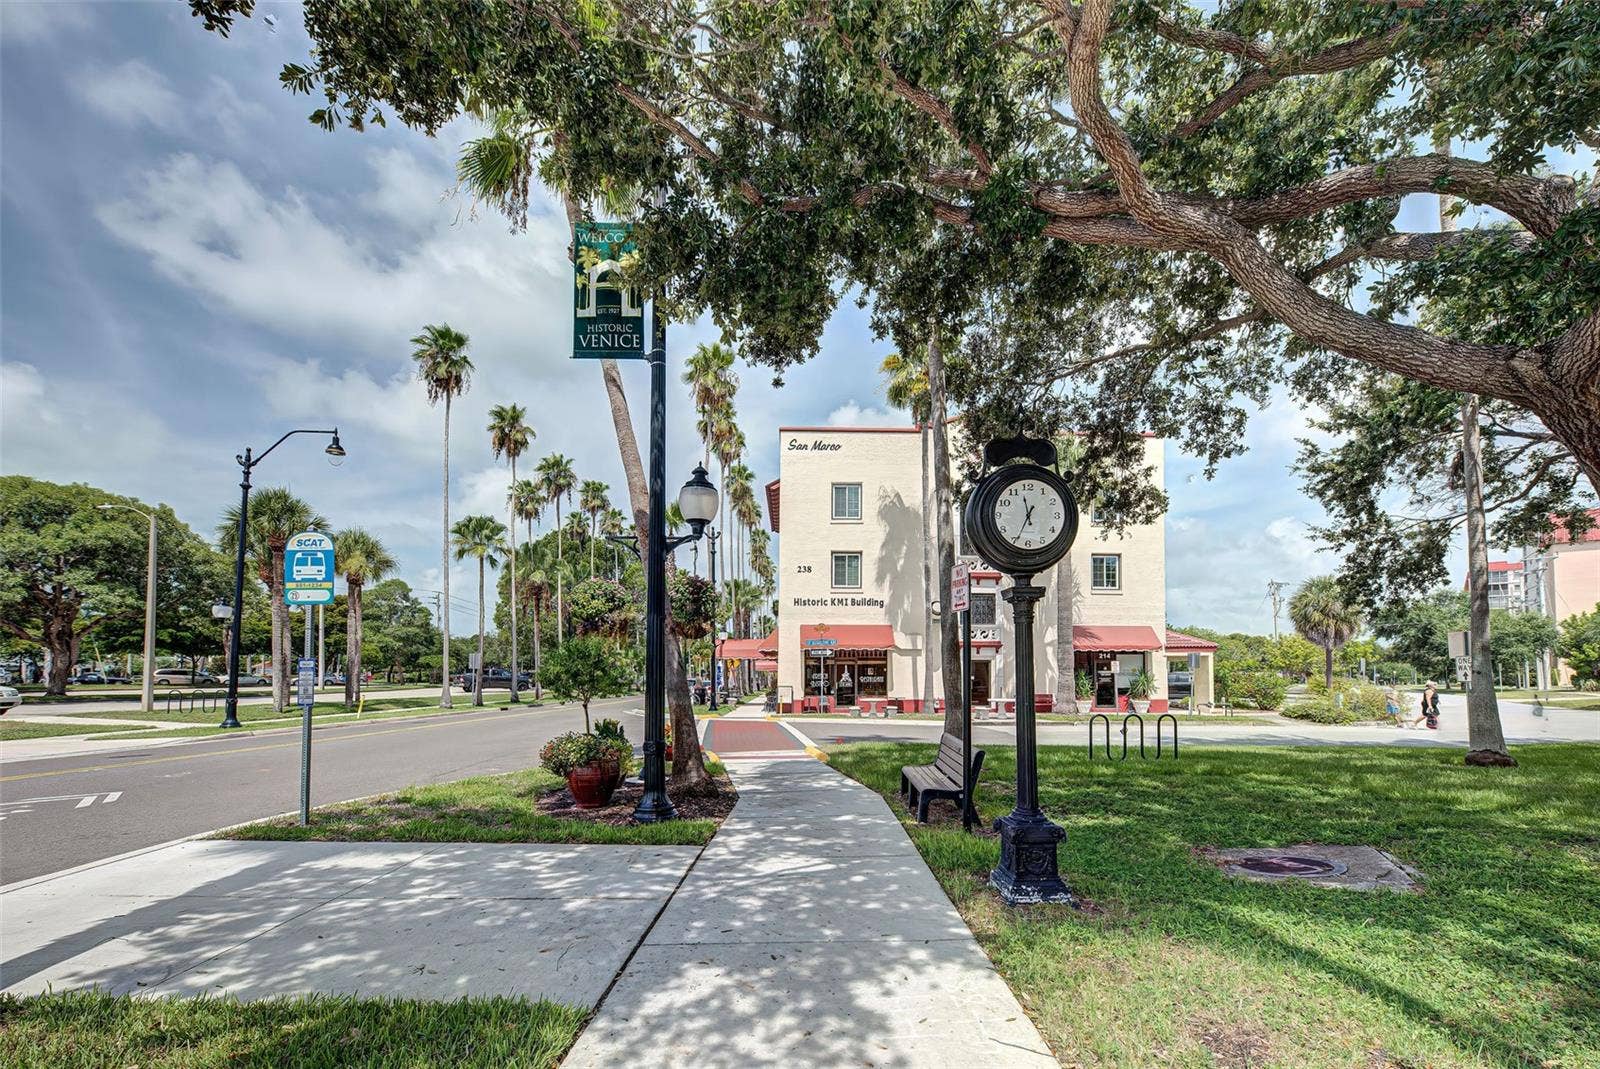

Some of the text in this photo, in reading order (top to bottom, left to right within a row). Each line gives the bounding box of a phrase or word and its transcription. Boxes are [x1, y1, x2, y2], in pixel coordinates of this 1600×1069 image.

[577, 232, 625, 243] WELCO
[586, 323, 633, 333] HISTORIC
[579, 333, 641, 348] VENICE
[787, 438, 842, 452] San Marco
[1008, 488, 1019, 496] 11
[1022, 483, 1034, 492] 12
[1040, 487, 1046, 495] 1
[999, 498, 1011, 507] 10
[1049, 497, 1057, 506] 2
[995, 511, 1002, 520] 9
[1054, 511, 1061, 520] 3
[999, 526, 1007, 534] 8
[1048, 525, 1056, 534] 4
[295, 538, 325, 547] SCAT
[1010, 536, 1018, 545] 7
[1024, 540, 1032, 548] 6
[1039, 536, 1046, 545] 5
[797, 565, 812, 574] 238
[793, 597, 884, 609] Historic KMI Building
